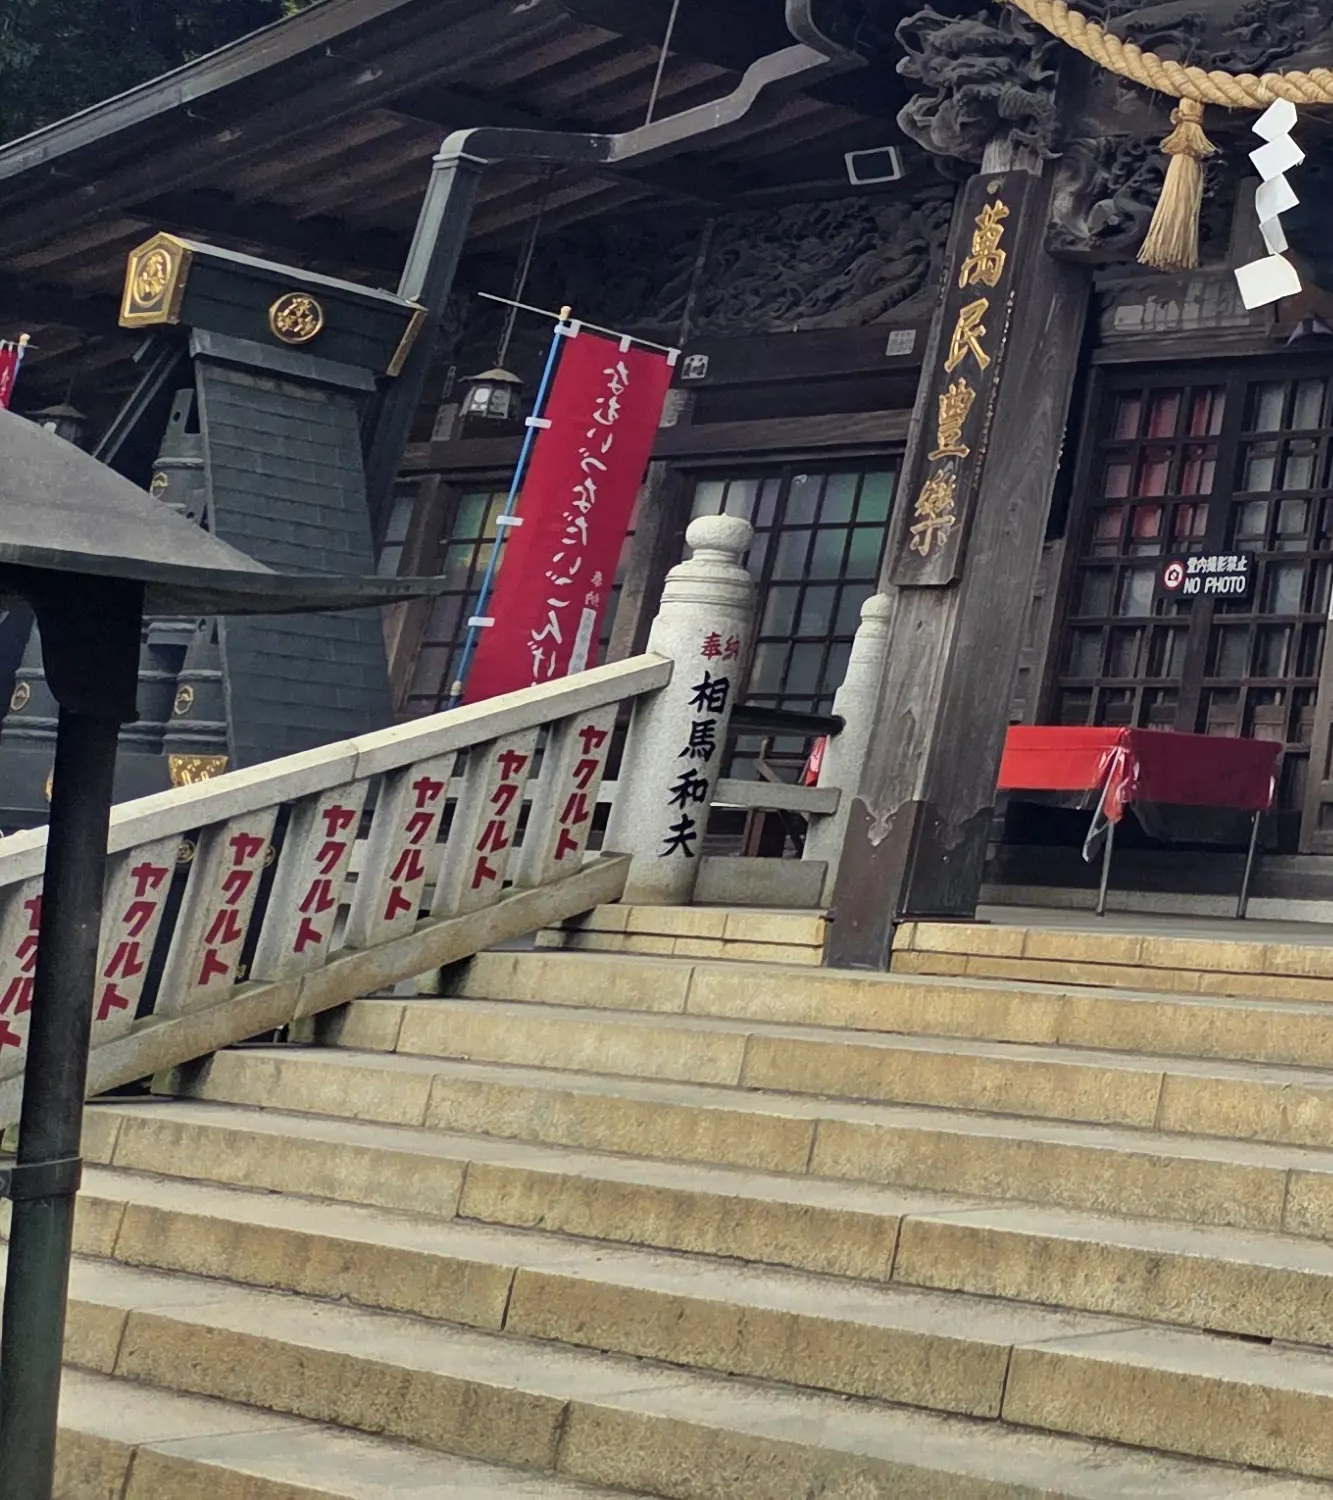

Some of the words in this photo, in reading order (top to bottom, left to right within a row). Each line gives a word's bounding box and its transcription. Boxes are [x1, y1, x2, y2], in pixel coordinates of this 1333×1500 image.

[1183, 577, 1201, 594] NO
[1204, 575, 1246, 594] PHOTO
[1187, 555, 1248, 574] 堂内撮影禁止
[471, 748, 529, 890] ヤクルト
[554, 724, 609, 861] ヤクルト
[658, 670, 730, 858] 相馬和夫
[198, 831, 267, 986] ヤクルト
[294, 804, 357, 953] ヤクルト
[384, 775, 446, 921] ヤクルト
[96, 861, 169, 1021] ヤクルト
